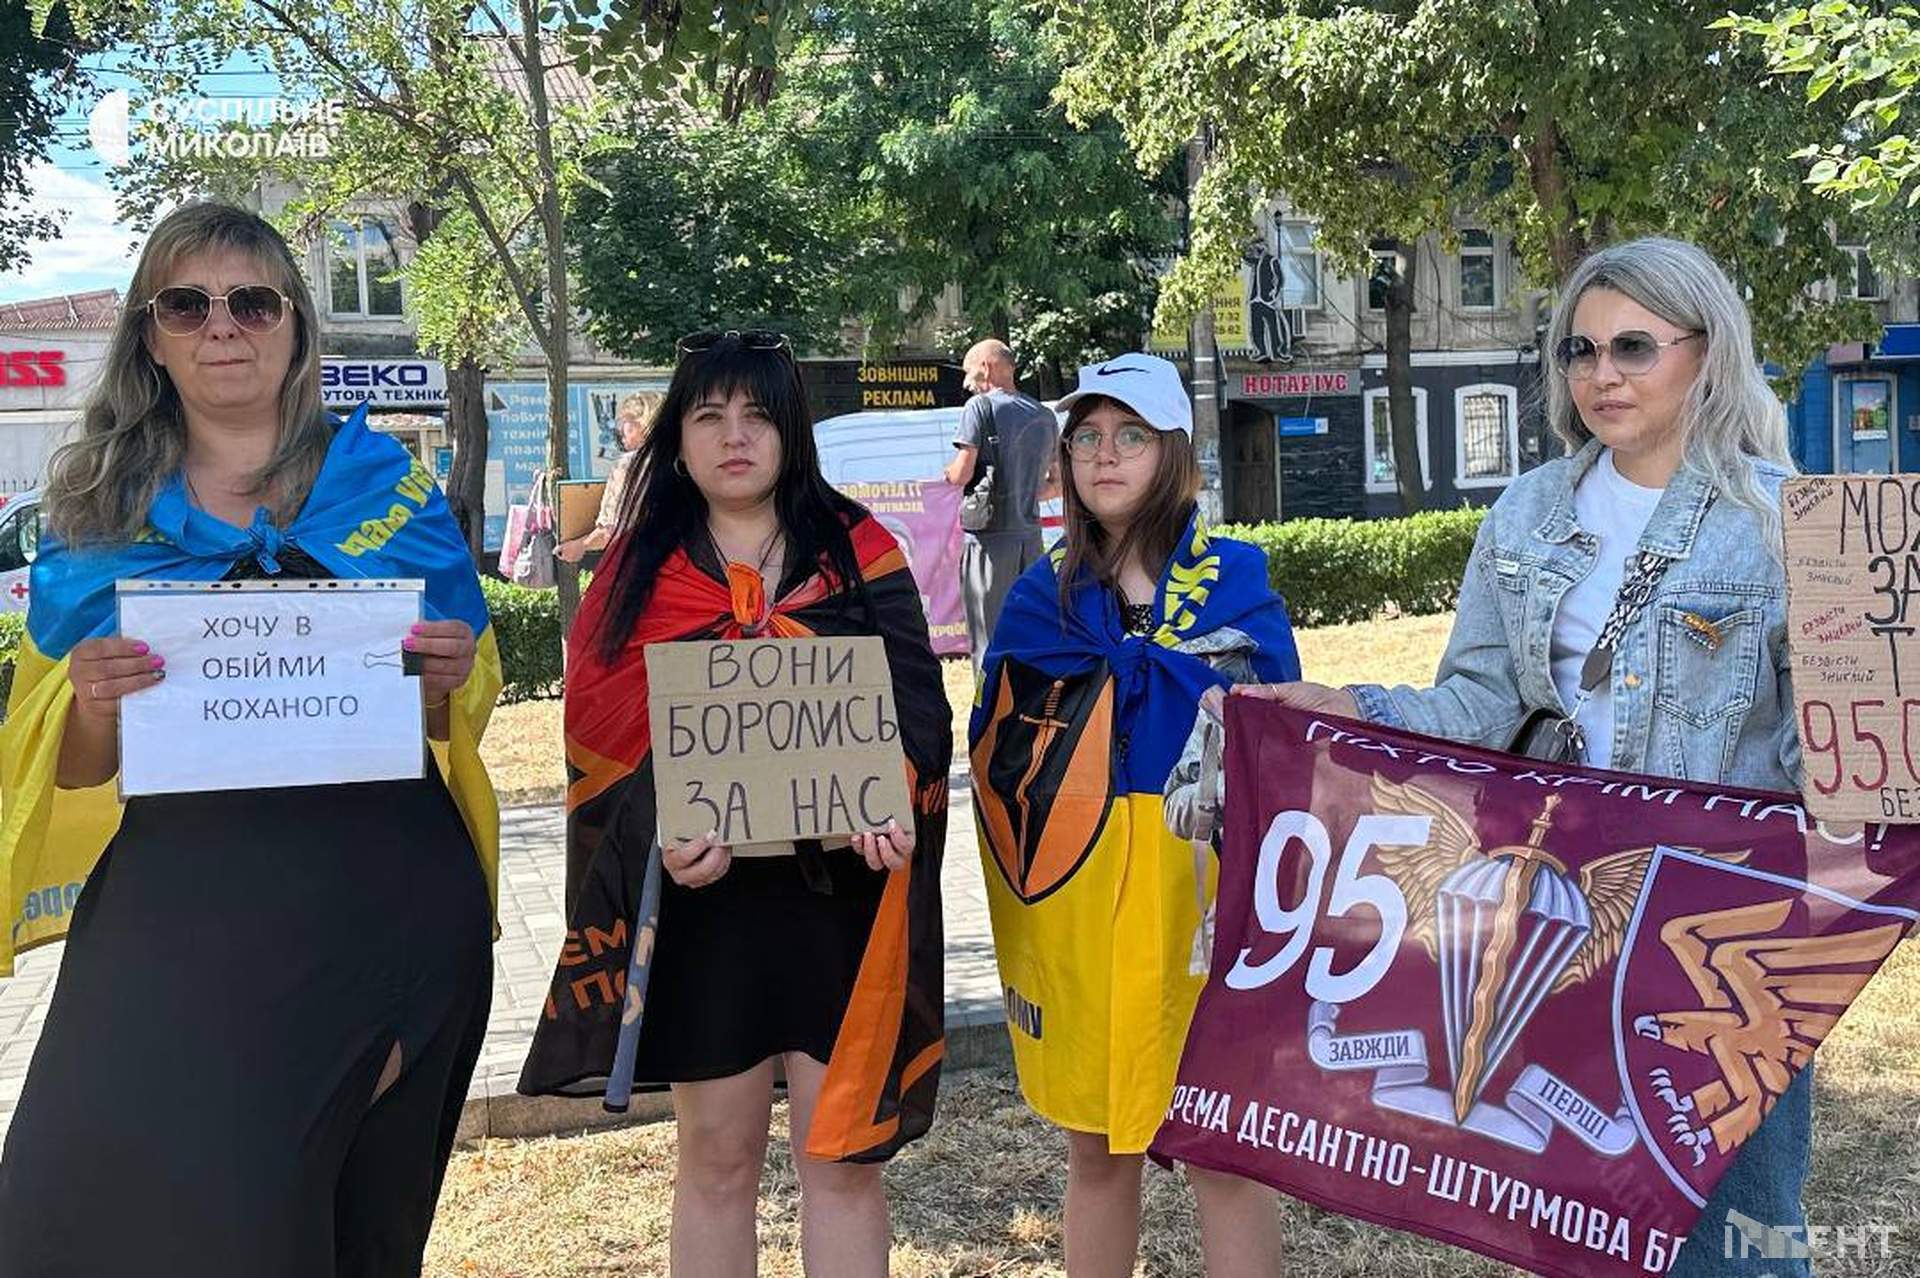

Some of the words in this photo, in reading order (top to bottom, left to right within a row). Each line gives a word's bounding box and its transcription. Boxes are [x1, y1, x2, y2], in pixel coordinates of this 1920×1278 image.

[322, 365, 428, 386] BEKO
[857, 366, 938, 382] ЗОВНІШНЯ
[1243, 373, 1348, 394] НОТАРІУС
[323, 390, 377, 401] УТОВА
[863, 389, 935, 406] РЕКЛАМА
[202, 616, 279, 639] ХОЧУ
[297, 615, 312, 636] В
[202, 652, 326, 680] ОБІЙМИ
[708, 644, 853, 689] ВОНИ
[203, 695, 359, 721] КОХАНОГО
[669, 695, 899, 758] БОРОЛИСЬ
[686, 780, 751, 841] ЗА
[791, 773, 893, 836] НАС
[1224, 810, 1433, 1004] 95
[1328, 1034, 1410, 1062] ЗАВЖДИ
[1538, 1077, 1609, 1140] ПЕРШІ
[1164, 1084, 1232, 1134] РЕМА
[1237, 1101, 1630, 1262] ДЕСАНТНО-ШТУРМОВА
